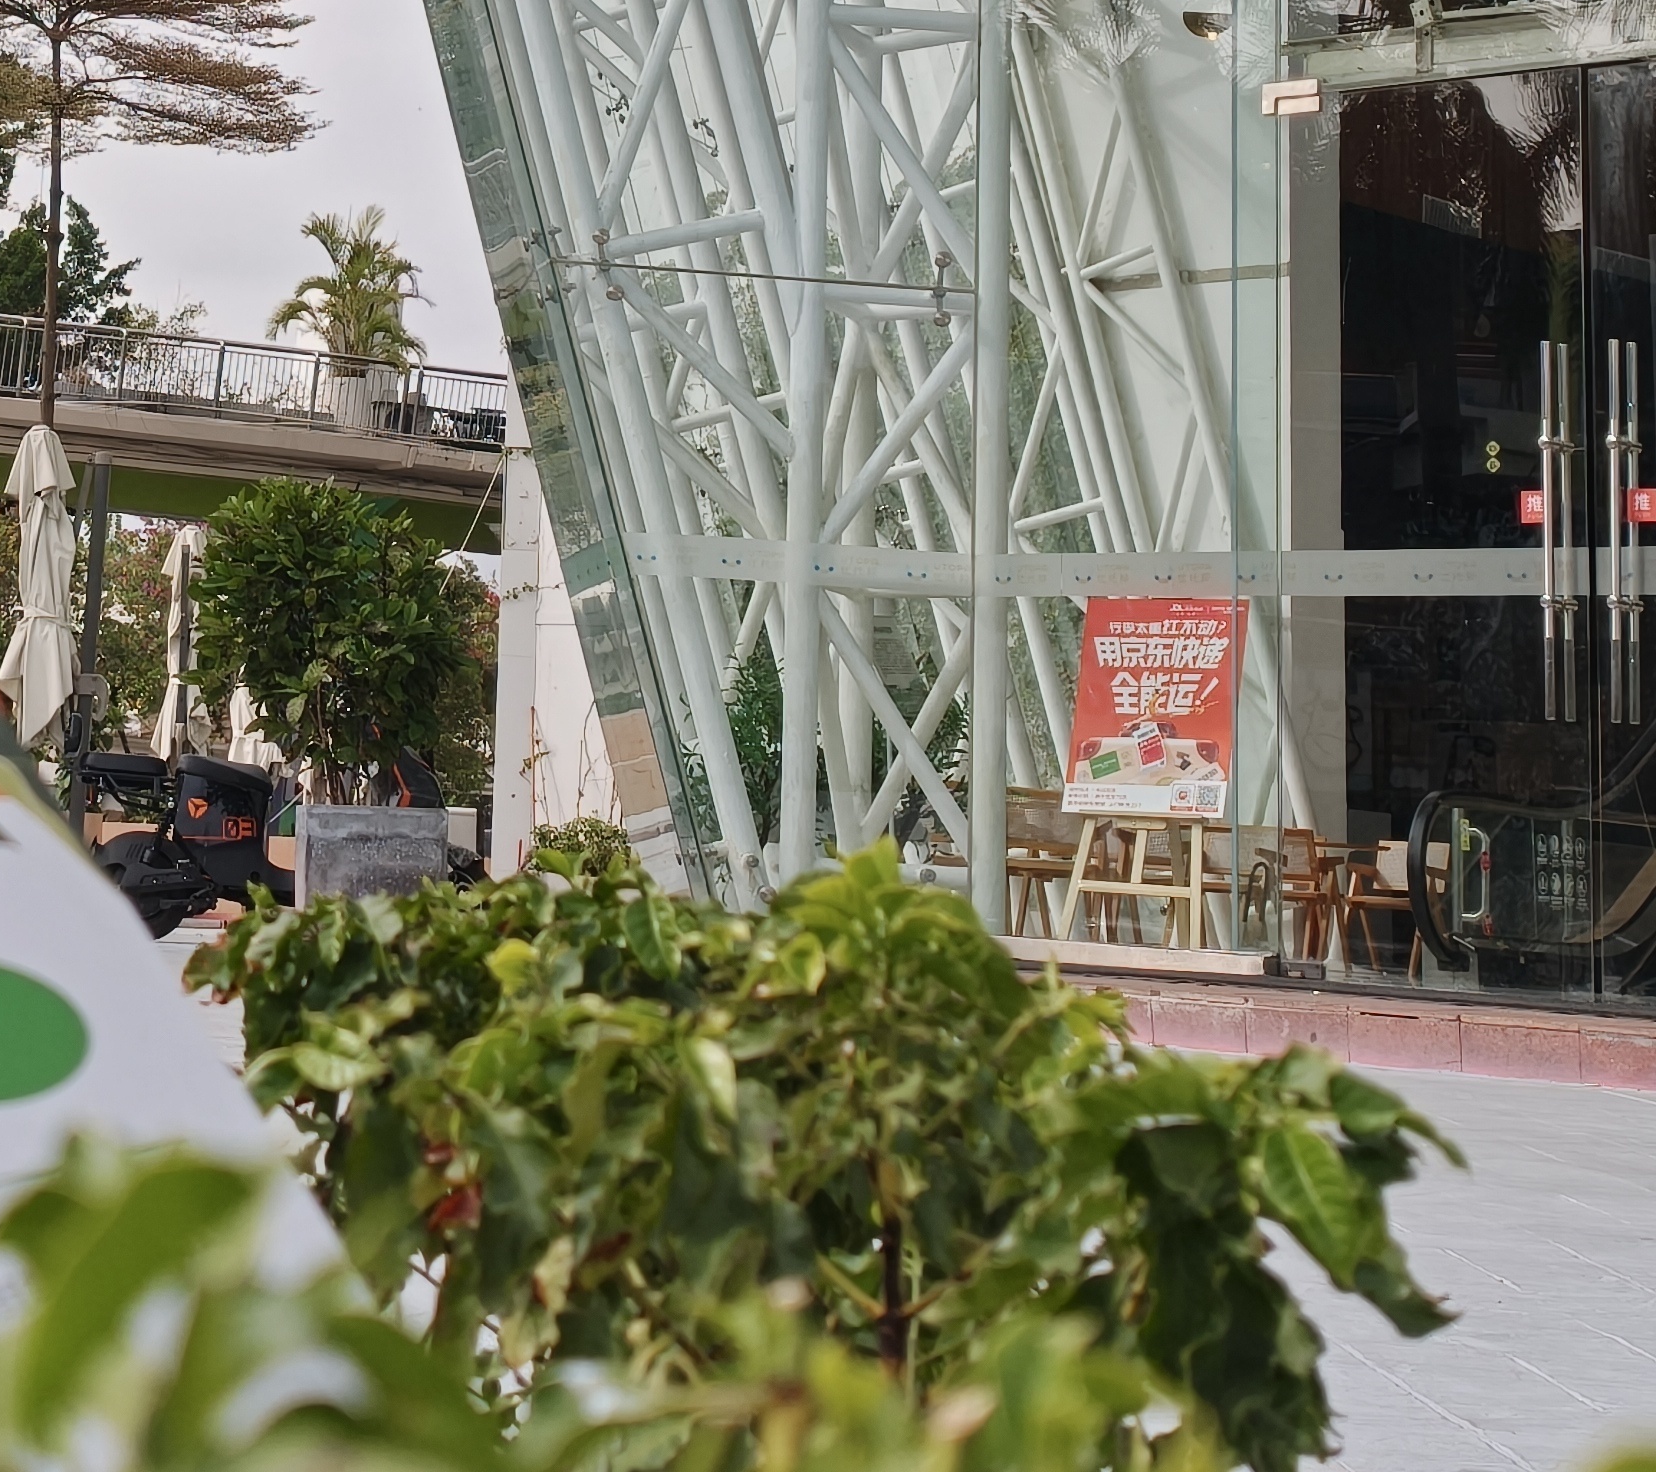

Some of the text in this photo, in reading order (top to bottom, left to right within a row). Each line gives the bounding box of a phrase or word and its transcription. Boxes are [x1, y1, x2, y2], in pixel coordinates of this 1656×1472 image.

[1634, 492, 1651, 511] 推
[1094, 636, 1230, 669] 用京东快递
[1110, 671, 1219, 716] 全能运！
